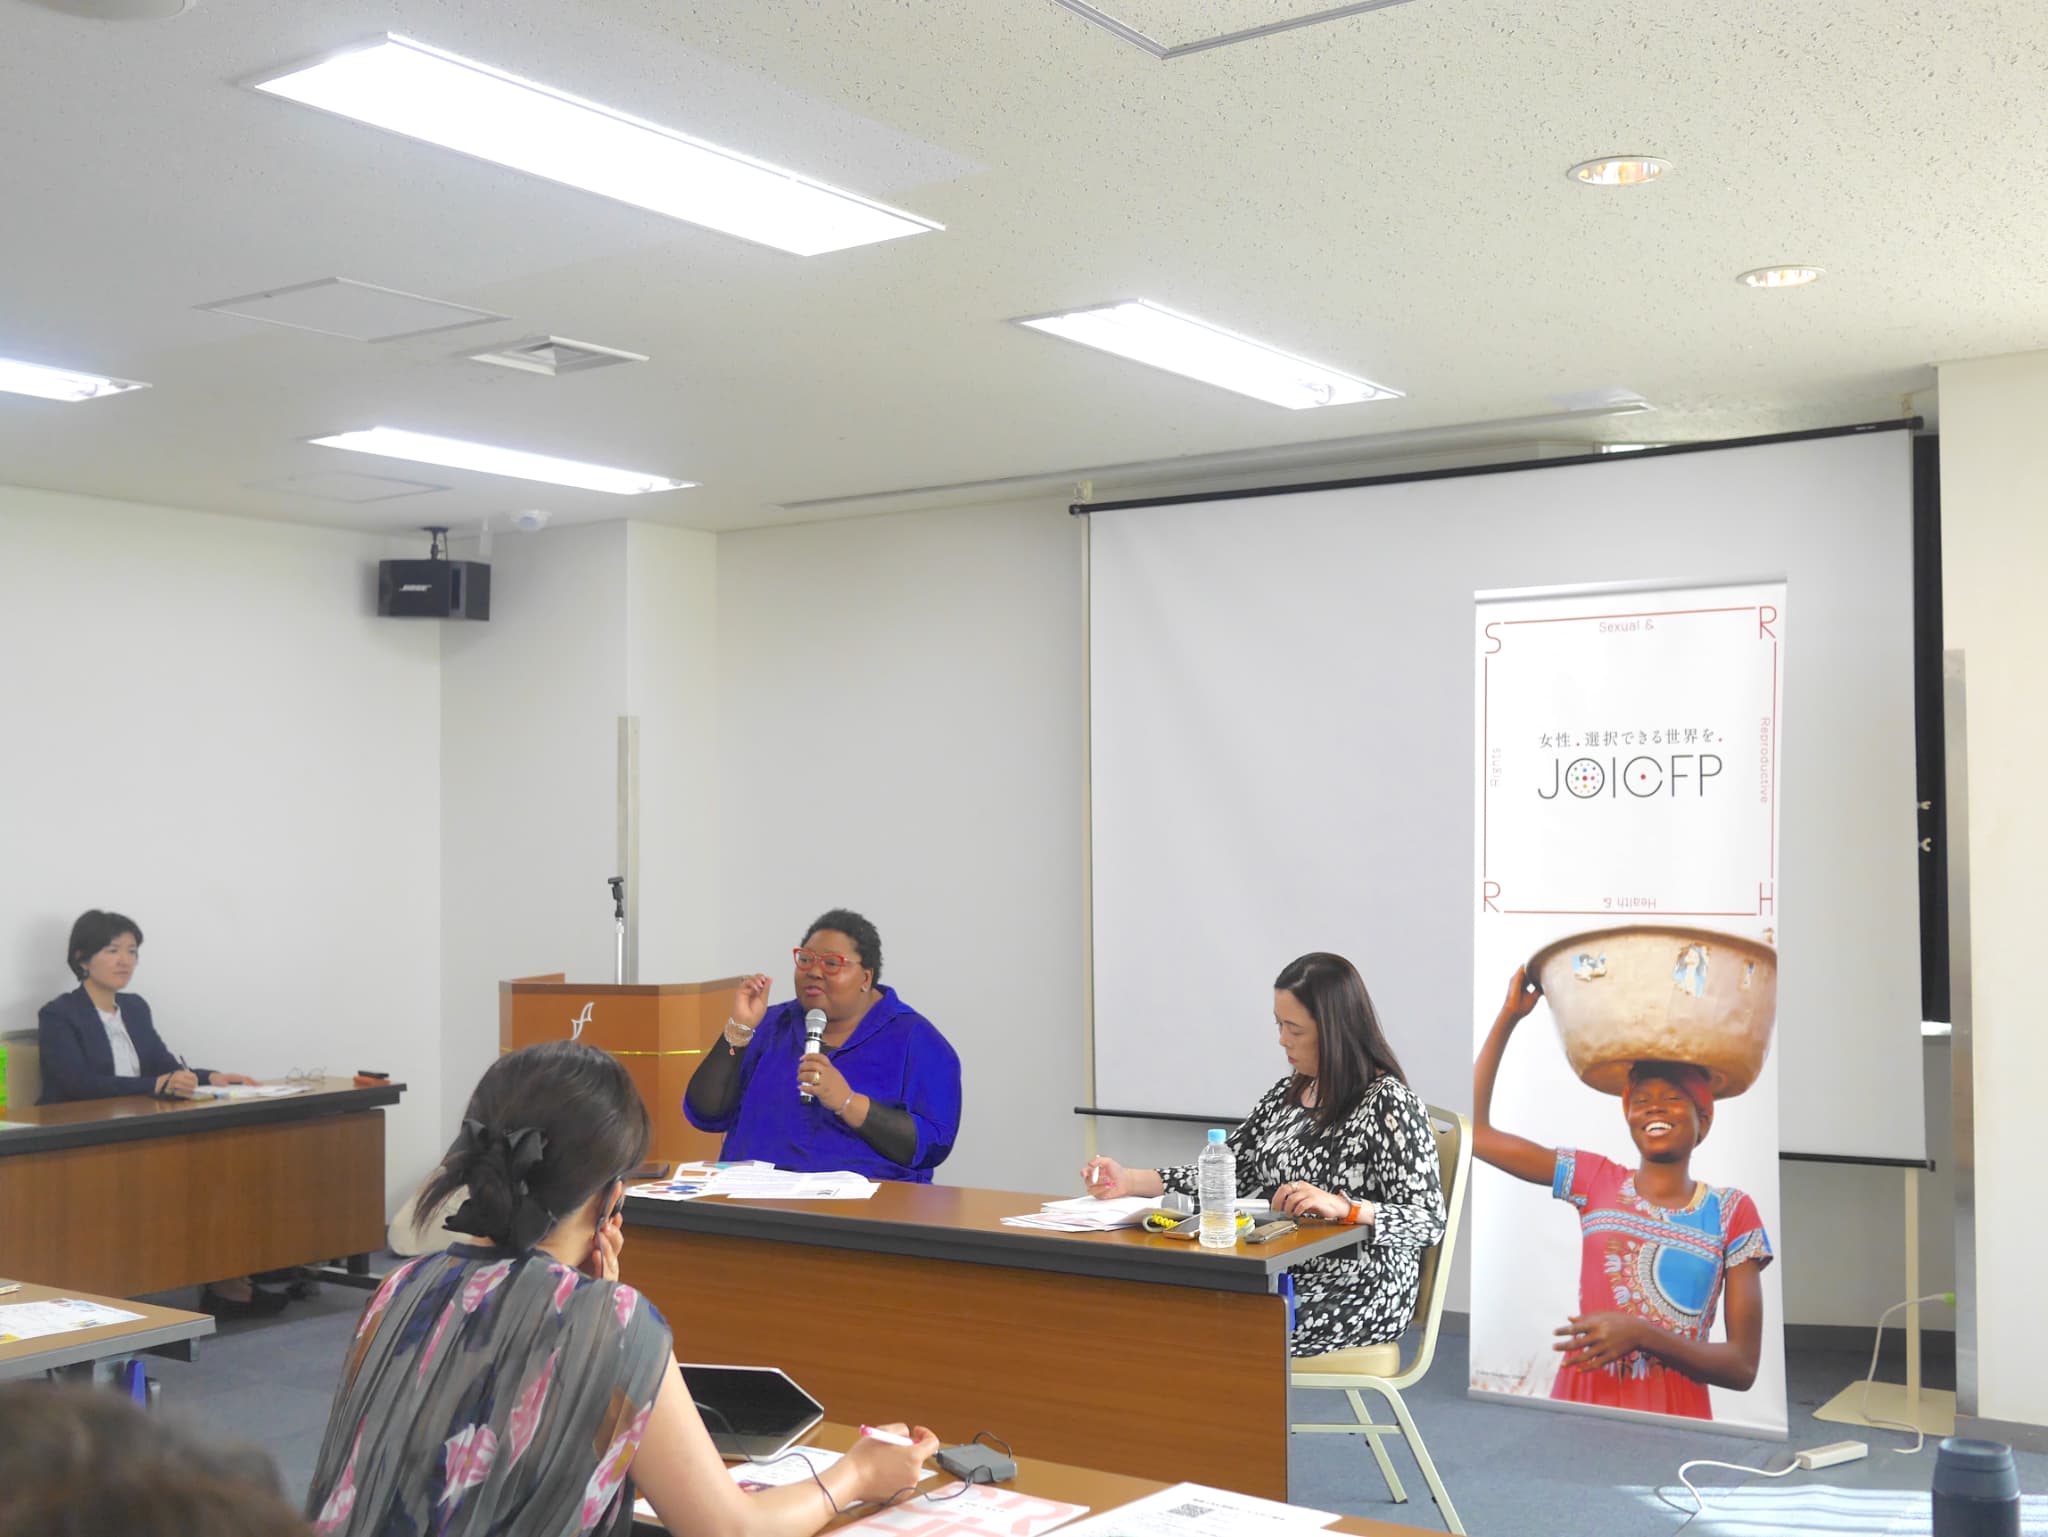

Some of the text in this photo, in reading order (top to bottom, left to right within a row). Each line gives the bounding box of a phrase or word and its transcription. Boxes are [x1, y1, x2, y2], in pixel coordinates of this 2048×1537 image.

[1484, 622, 1502, 654] S
[1599, 618, 1640, 633] Sexual
[1759, 605, 1777, 639] R
[1537, 754, 1723, 800] JOICFP
[1760, 717, 1770, 804] Reproductive
[1483, 881, 1501, 912] R
[1759, 882, 1773, 915] H
